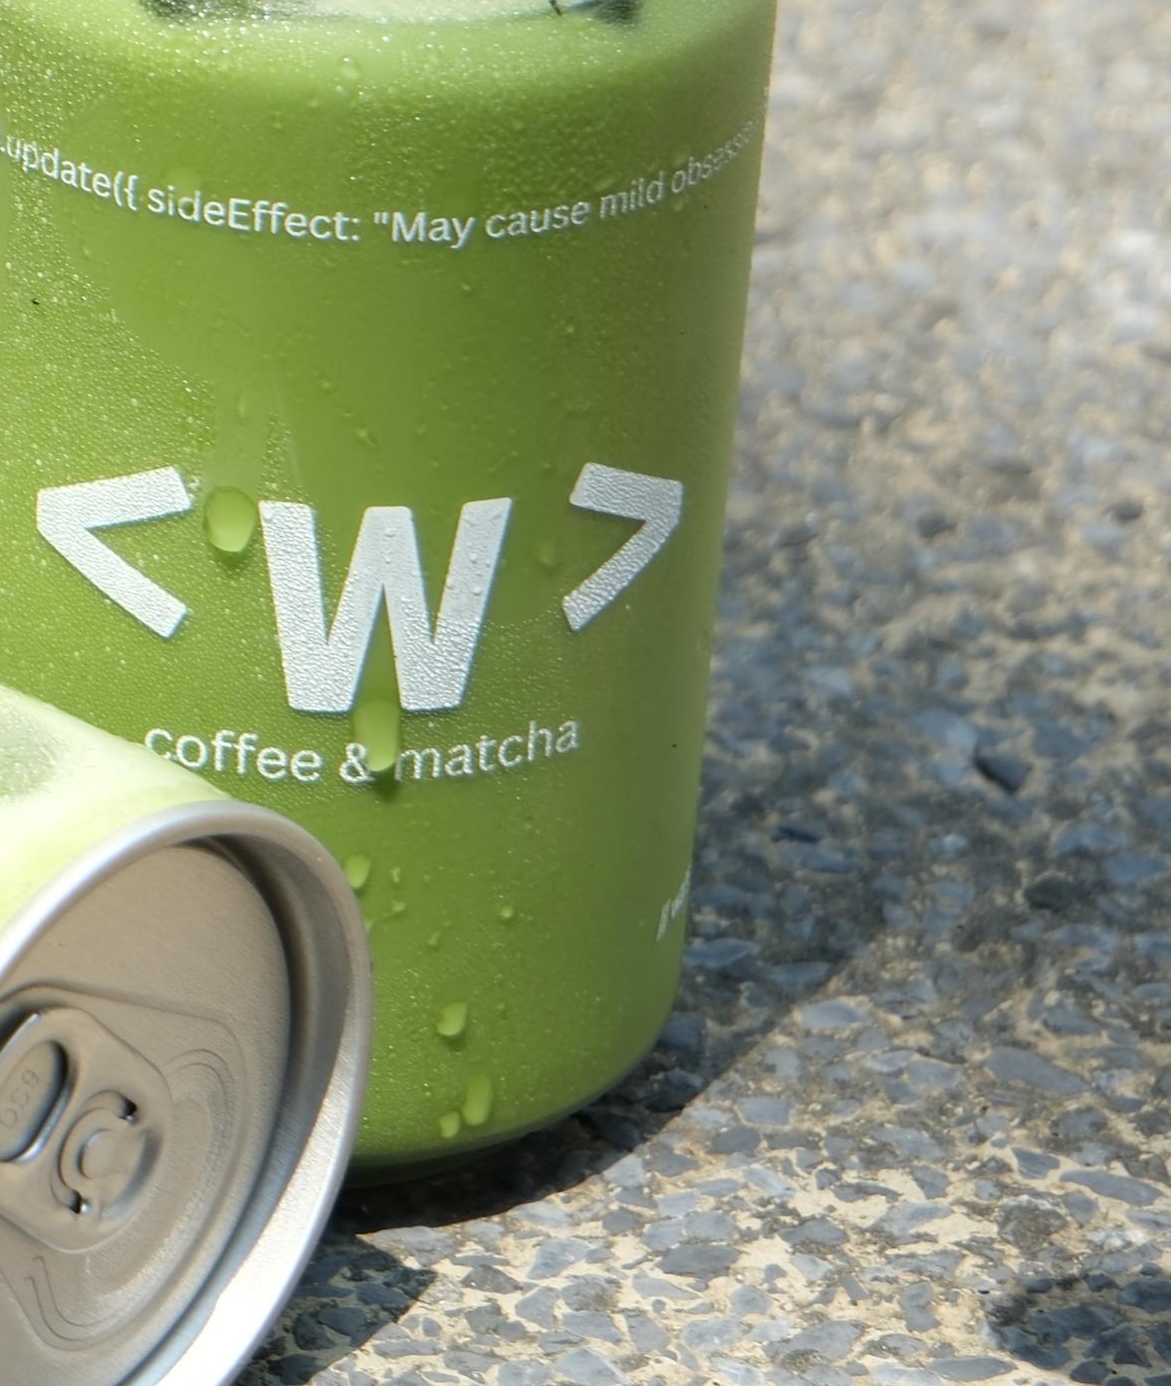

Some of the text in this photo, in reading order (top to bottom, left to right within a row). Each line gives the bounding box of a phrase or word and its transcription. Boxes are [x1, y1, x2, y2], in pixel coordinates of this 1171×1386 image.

[148, 184, 361, 241] sideEffect:
[485, 201, 590, 237] cause
[599, 170, 664, 220] mild
[144, 719, 580, 784] coffee & matcha
